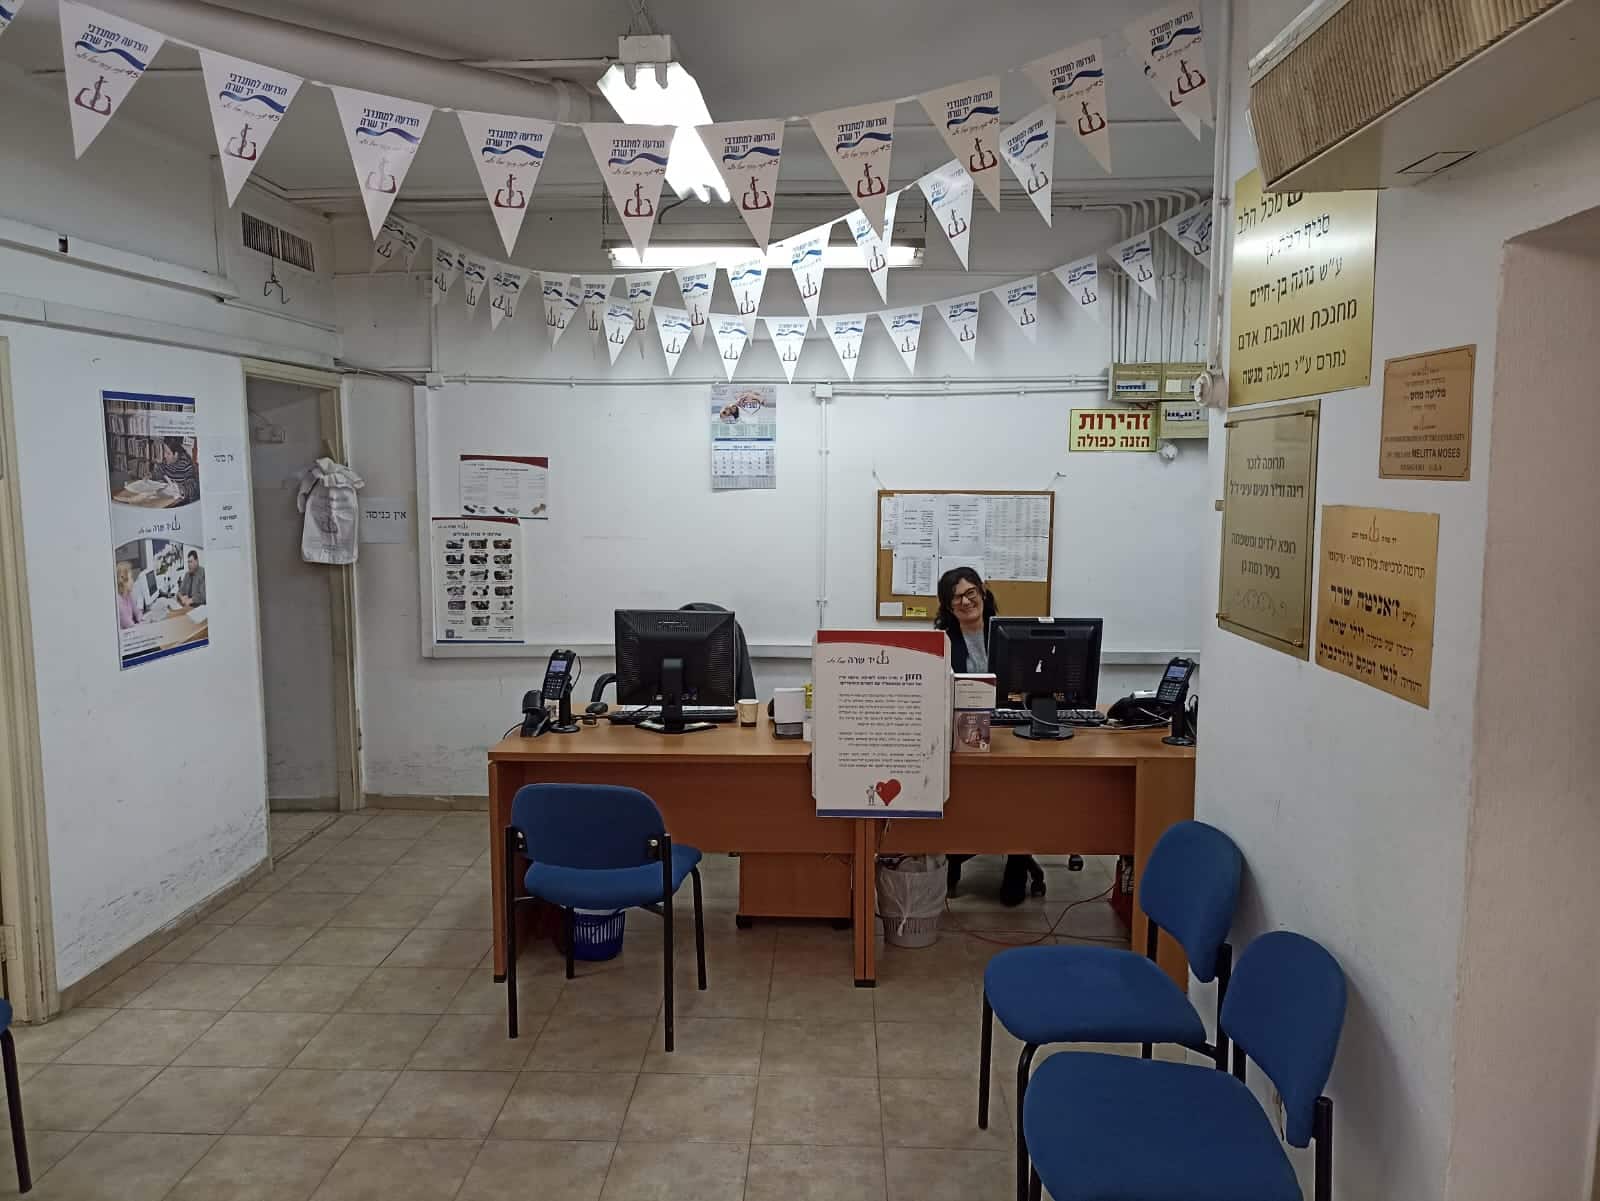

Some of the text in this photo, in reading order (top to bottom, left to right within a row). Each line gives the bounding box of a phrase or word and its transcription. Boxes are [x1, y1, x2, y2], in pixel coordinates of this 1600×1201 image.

[81, 32, 112, 48] יד שרה
[88, 24, 148, 53] הצדעה למתנדבי
[1050, 54, 1096, 76] הצדעה למתנדבי
[225, 82, 254, 95] יד שרה
[230, 73, 288, 96] הצדעה למתנדבי
[947, 90, 993, 109] הצדעה למתנדבי
[360, 118, 388, 130] יד שרה
[363, 108, 420, 128] הצדעה למתנדבי
[837, 116, 888, 133] הצדעה למתנדבי
[488, 128, 543, 142] הצדעה למתנדבי
[724, 132, 776, 145] הצדעה למתנדבי
[836, 130, 862, 142] יד שרה
[486, 138, 512, 148] יד שרה
[612, 138, 665, 149] הצדעה למתנדבי
[724, 144, 748, 154] יד שרה
[611, 149, 637, 158] יד שרה
[1238, 206, 1257, 235] הלב
[1250, 276, 1288, 308] בן-חיים
[1238, 298, 1358, 351] מחנכת ואוהבת אדם
[1242, 349, 1346, 386] נתרם ע"י בעלה מנשה
[1078, 413, 1152, 430] זהירות
[1077, 433, 1150, 448] הזנה כפולה
[1438, 447, 1460, 458] MOSES
[1247, 454, 1285, 470] תרומה לזכר
[366, 511, 407, 520] אין כניסה
[1232, 532, 1296, 554] רופא ילדים ומשפחה
[1241, 560, 1280, 579] בעיר רמת גן
[1379, 560, 1402, 574] לרכישת
[1403, 564, 1426, 579] תרומה
[848, 656, 864, 664] שרה
[905, 673, 922, 682] חזון
